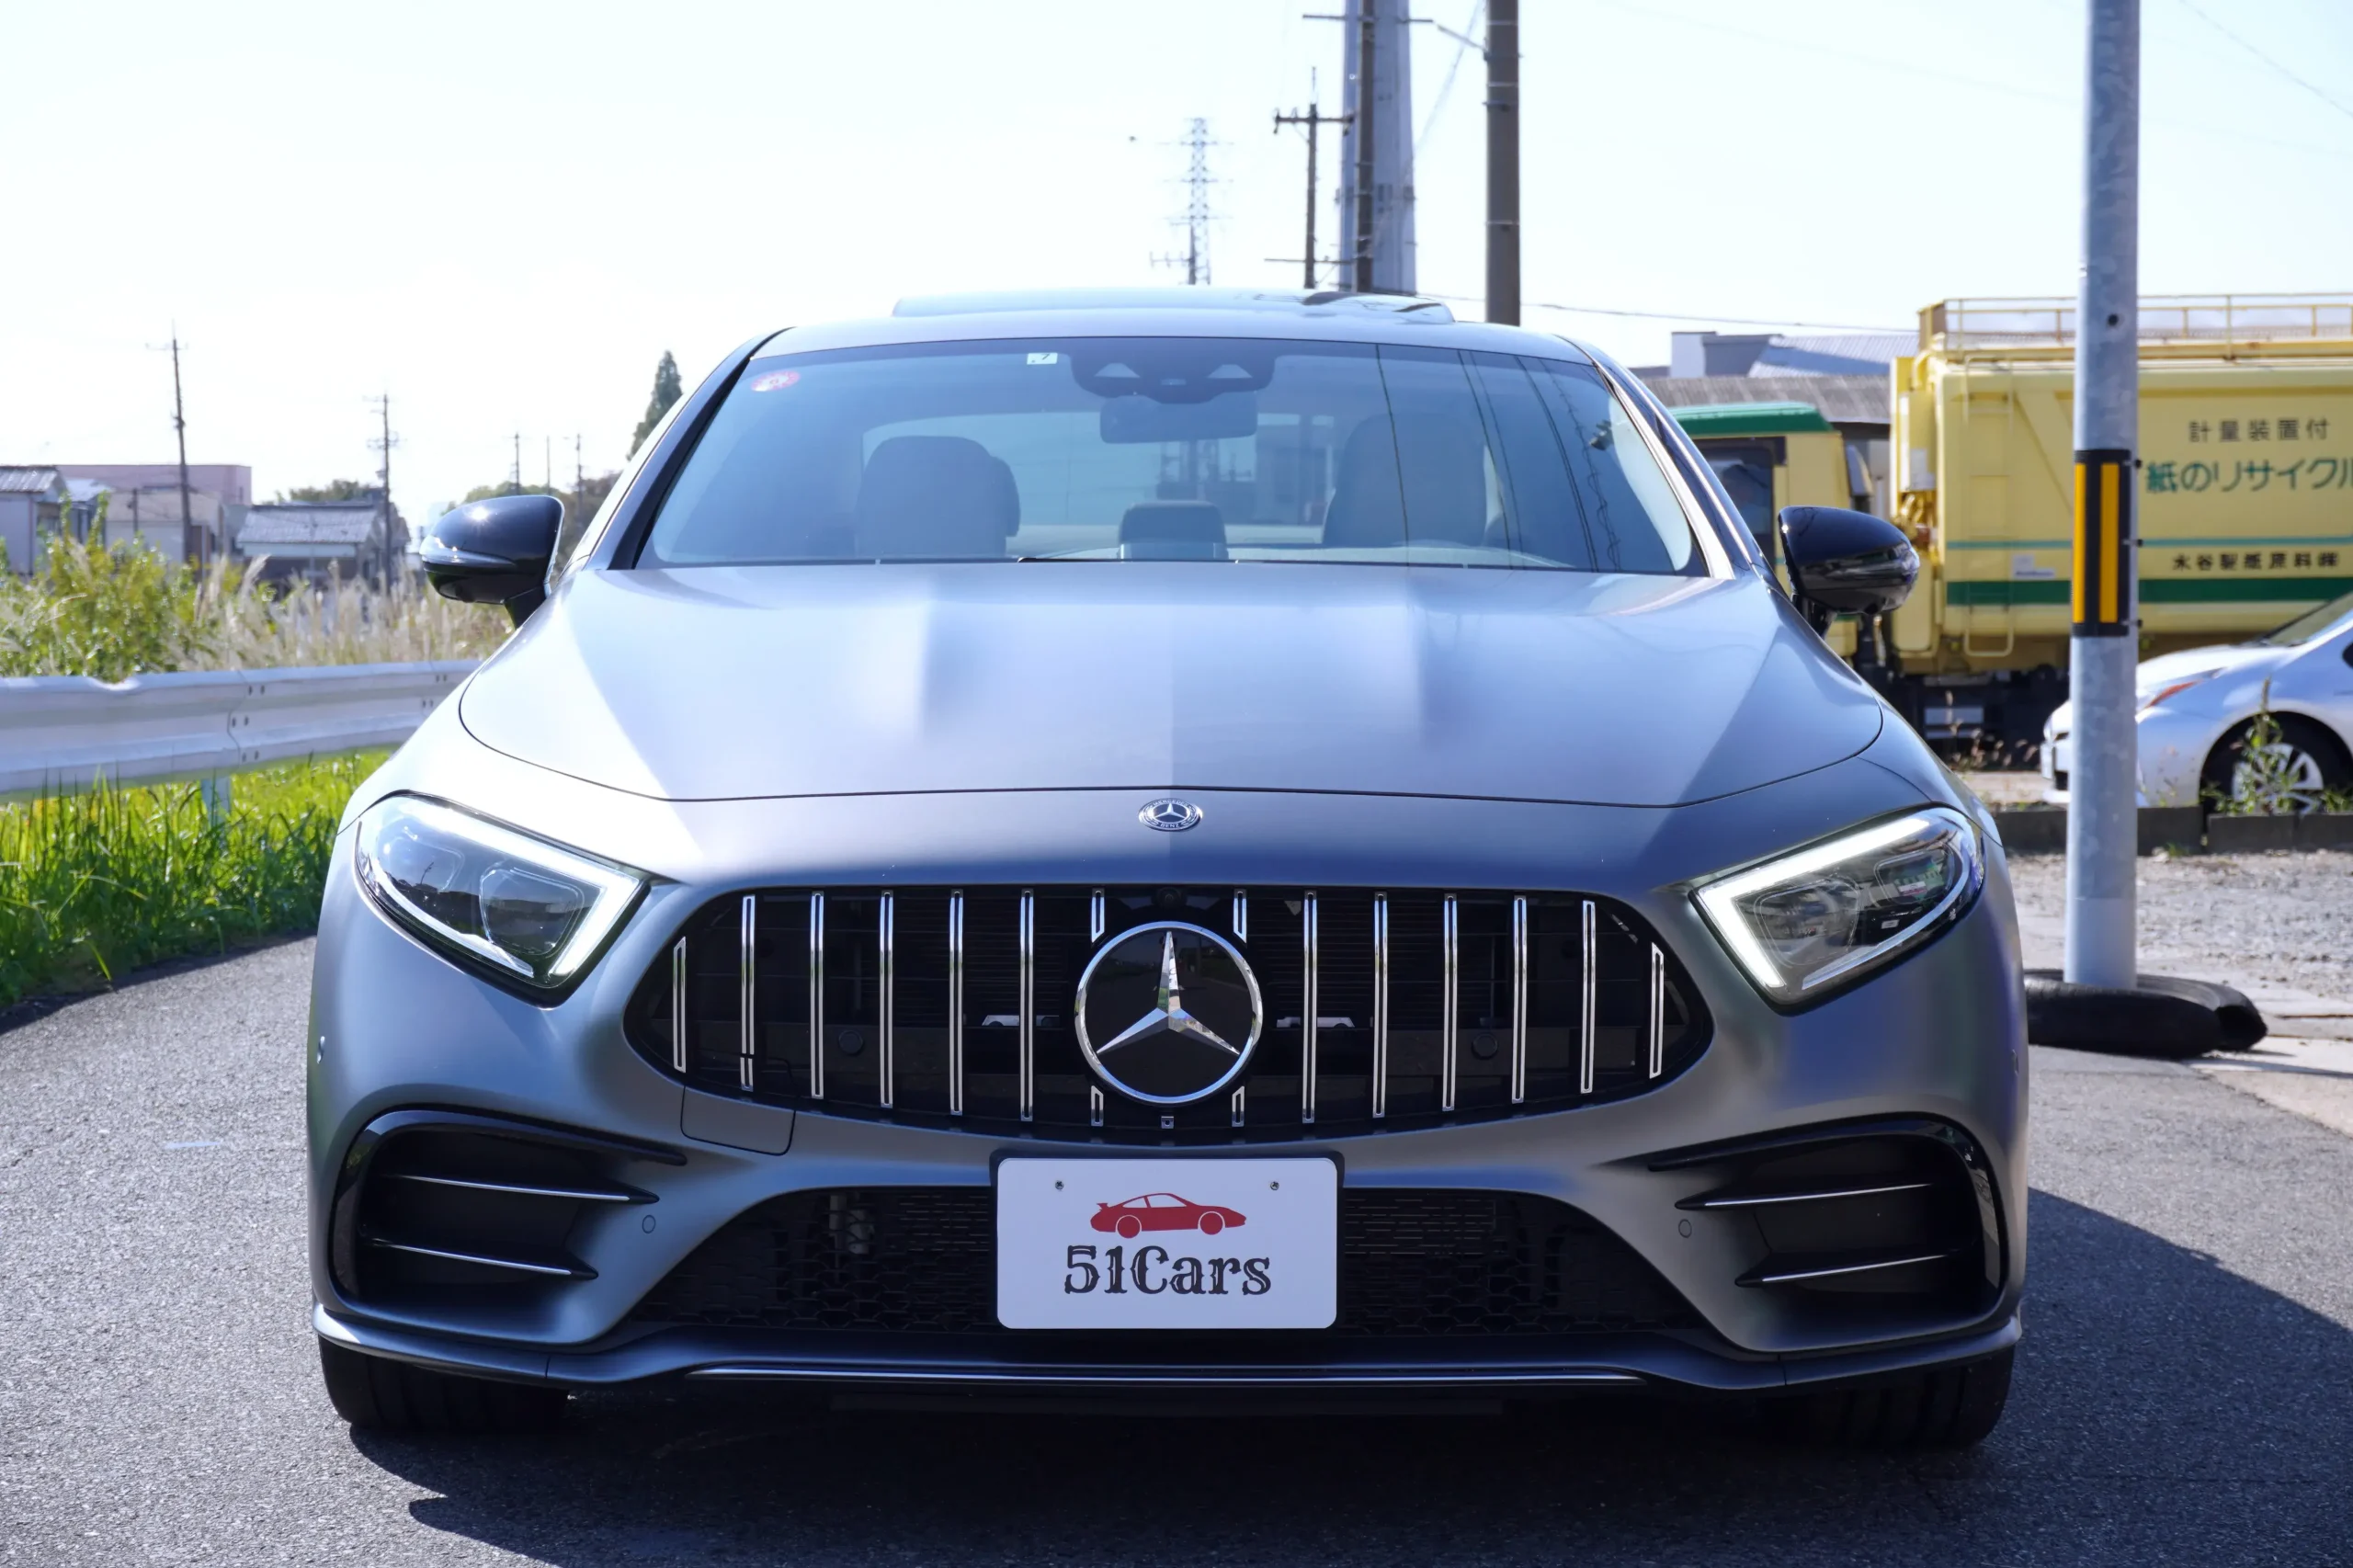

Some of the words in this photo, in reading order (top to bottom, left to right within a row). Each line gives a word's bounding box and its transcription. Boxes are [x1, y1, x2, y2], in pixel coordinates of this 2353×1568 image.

[2188, 417, 2330, 443] 計量装置付
[2145, 458, 2353, 493] 紙のリサイクル
[1064, 1244, 1271, 1296] 51Cars
